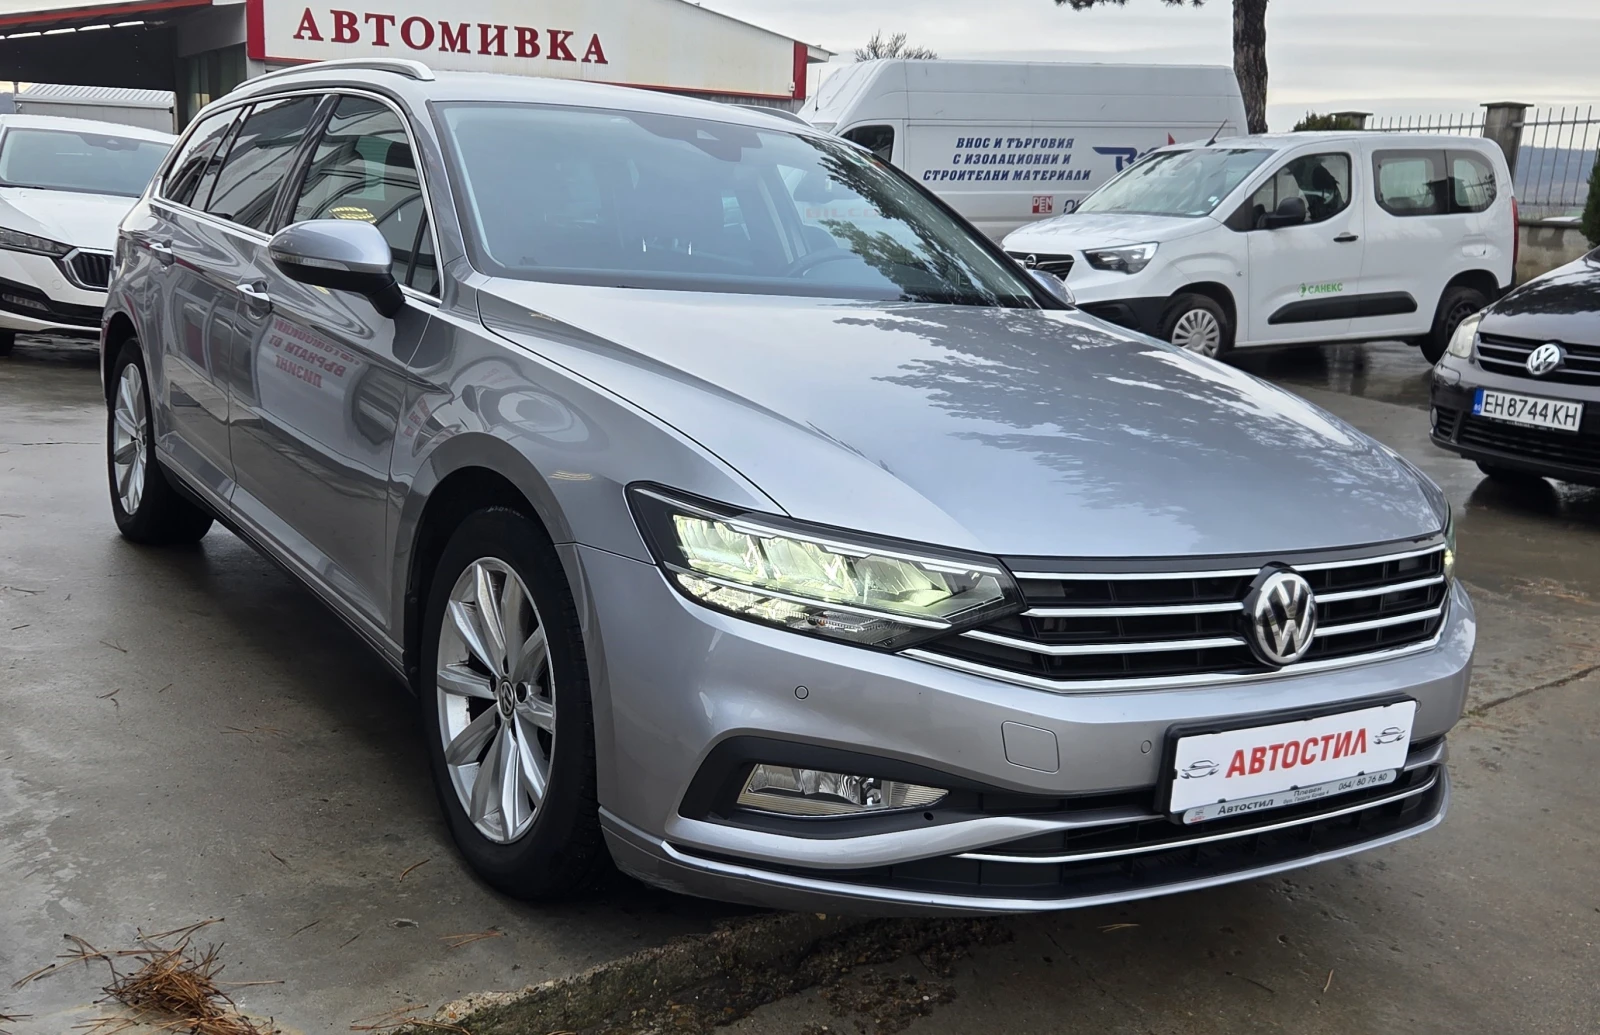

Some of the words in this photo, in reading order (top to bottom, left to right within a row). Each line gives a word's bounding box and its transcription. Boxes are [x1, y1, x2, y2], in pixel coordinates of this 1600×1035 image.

[293, 7, 608, 65] АВТОМИВКА
[956, 137, 991, 149] ВНОС
[993, 137, 1003, 149] И
[1006, 137, 1075, 149] ТЪРГОВИЯ
[952, 153, 962, 165] С
[964, 153, 1060, 166] ИЗОЛАЦИОННИ
[1062, 153, 1072, 165] И
[923, 169, 1010, 181] СТРОИТЕЛНИ
[1012, 169, 1092, 181] МАТЕРИАЛИ
[1308, 282, 1344, 294] САНЕКС
[1225, 728, 1367, 778] АВТОСТИЛ
[1217, 798, 1274, 815] Автостил
